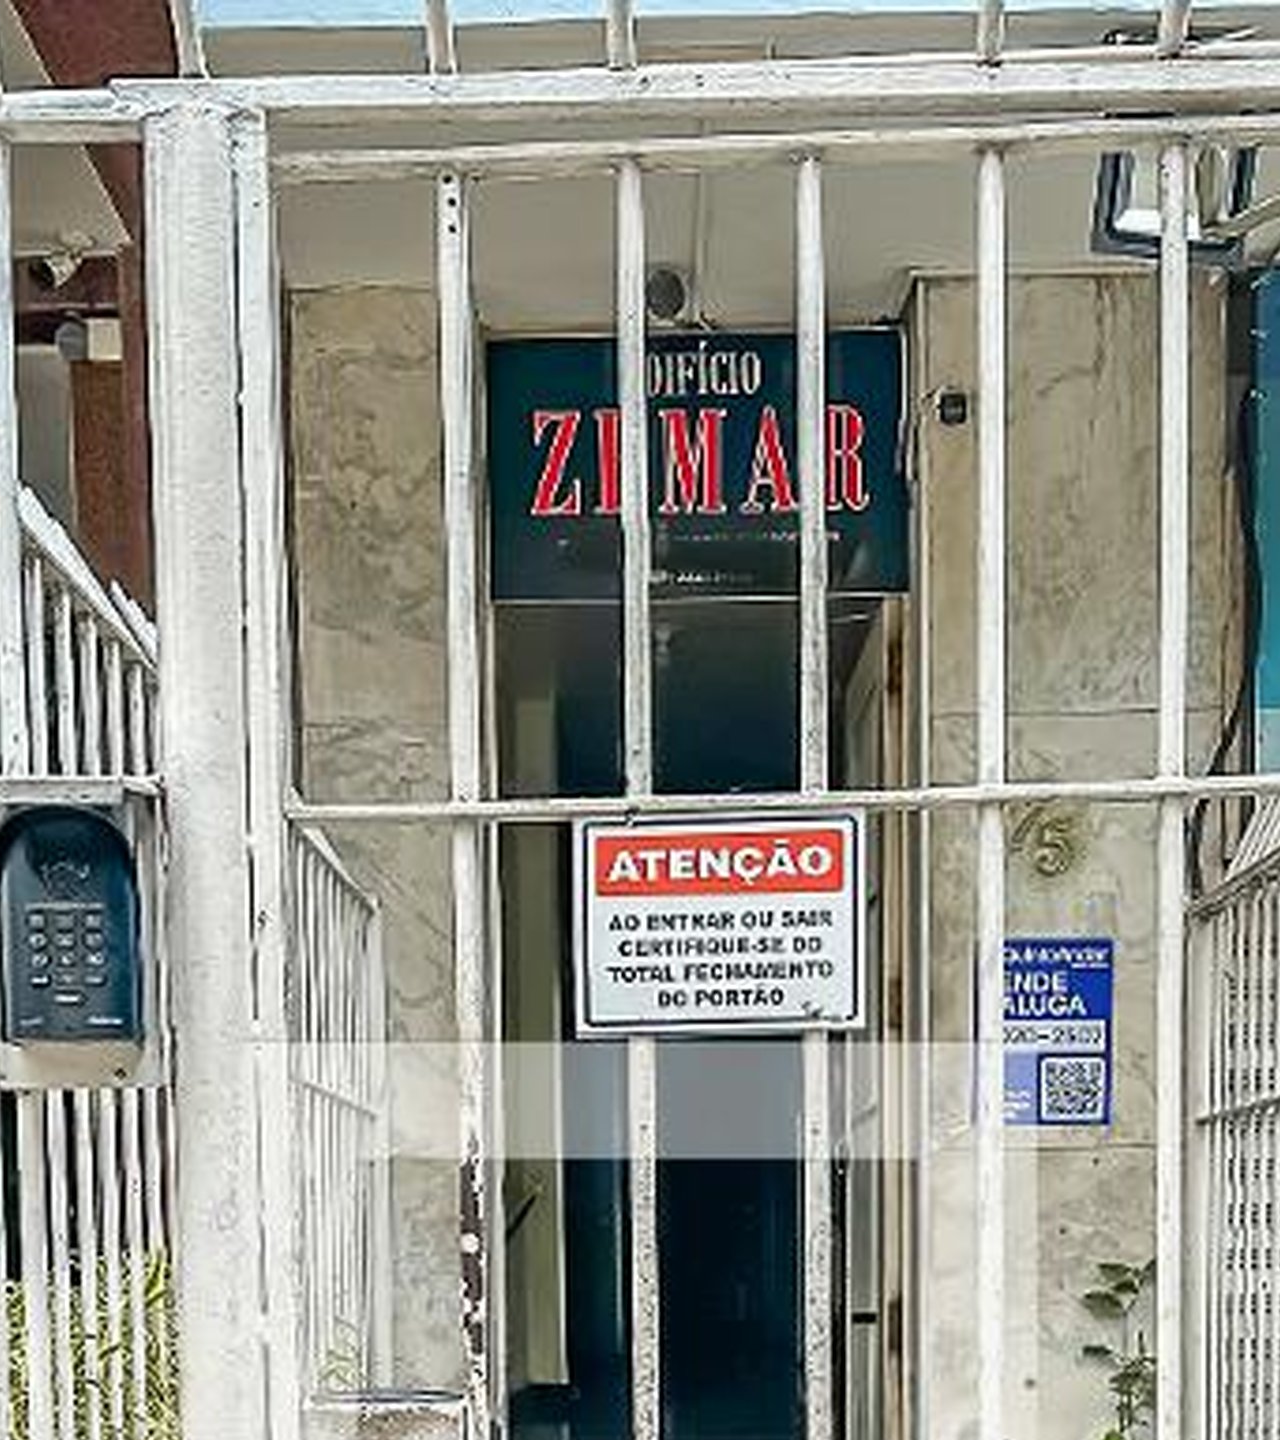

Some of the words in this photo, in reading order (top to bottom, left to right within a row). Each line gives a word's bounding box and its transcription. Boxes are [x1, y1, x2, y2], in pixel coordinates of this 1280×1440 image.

[645, 339, 762, 397] DIFÍCIO
[607, 838, 833, 886] ATENÇÃO
[608, 914, 641, 931] AO
[646, 912, 736, 931] ENTRAR
[740, 911, 773, 930] OU
[781, 910, 833, 928] SAIR
[618, 936, 784, 957] CERTIFIQUE-SE
[792, 936, 822, 954] DO
[605, 964, 675, 983] TOTAL
[683, 959, 834, 982] FECHAMENTO
[1003, 971, 1067, 992] ENDE
[657, 989, 687, 1007] DO
[694, 981, 785, 1006] PORTÃO
